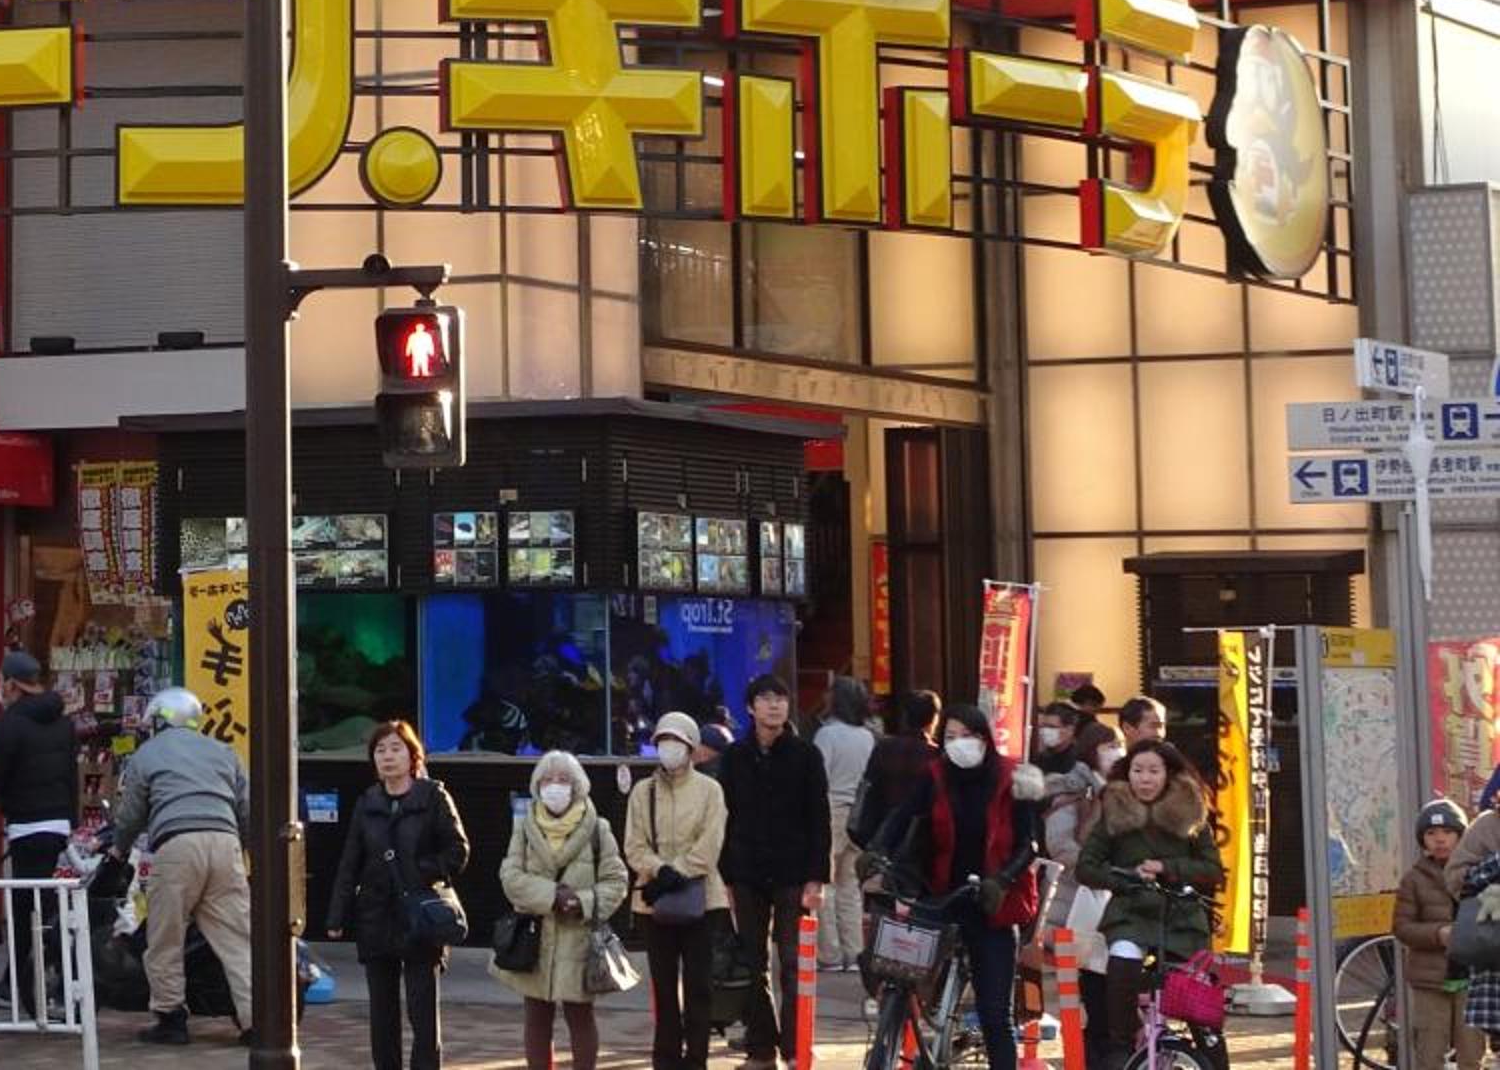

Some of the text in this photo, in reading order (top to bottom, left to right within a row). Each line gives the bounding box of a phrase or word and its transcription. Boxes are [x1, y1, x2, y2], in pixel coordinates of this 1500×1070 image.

[1375, 455, 1482, 475] 伊勢佐長者町駅
